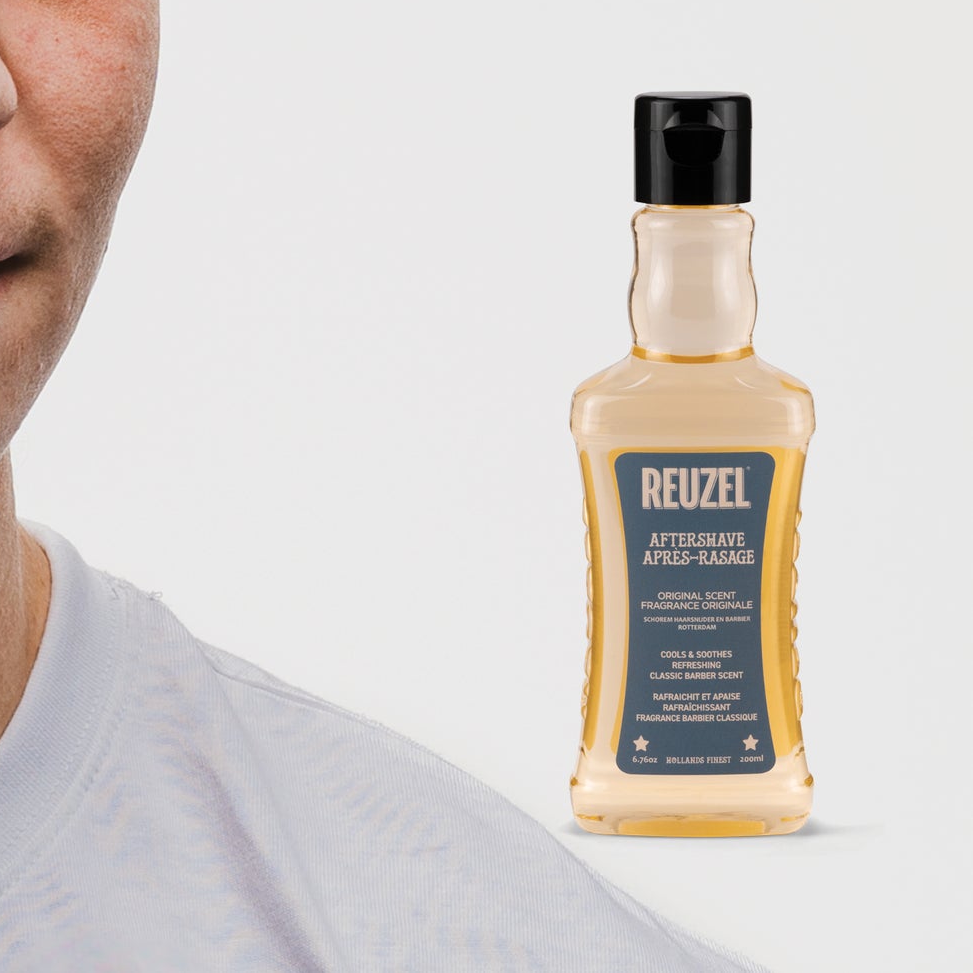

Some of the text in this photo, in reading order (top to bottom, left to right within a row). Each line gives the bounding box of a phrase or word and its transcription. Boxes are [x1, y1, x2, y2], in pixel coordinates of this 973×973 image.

[642, 467, 751, 510] REUZEL
[649, 532, 745, 547] AFTERSHAVE
[658, 591, 736, 600] ORIGINAL SCENT
[641, 601, 753, 610] FRAGRANCE ORIGINALE
[696, 650, 732, 658] SOOTHES
[672, 661, 721, 669] REFRESHING
[650, 672, 683, 680] CLASSIC
[718, 671, 744, 679] SCENT
[636, 713, 758, 722] FRAGRANCE BARBIER CLASSIQUE
[632, 756, 657, 764] 6.76oz
[740, 754, 763, 763] 200ml
